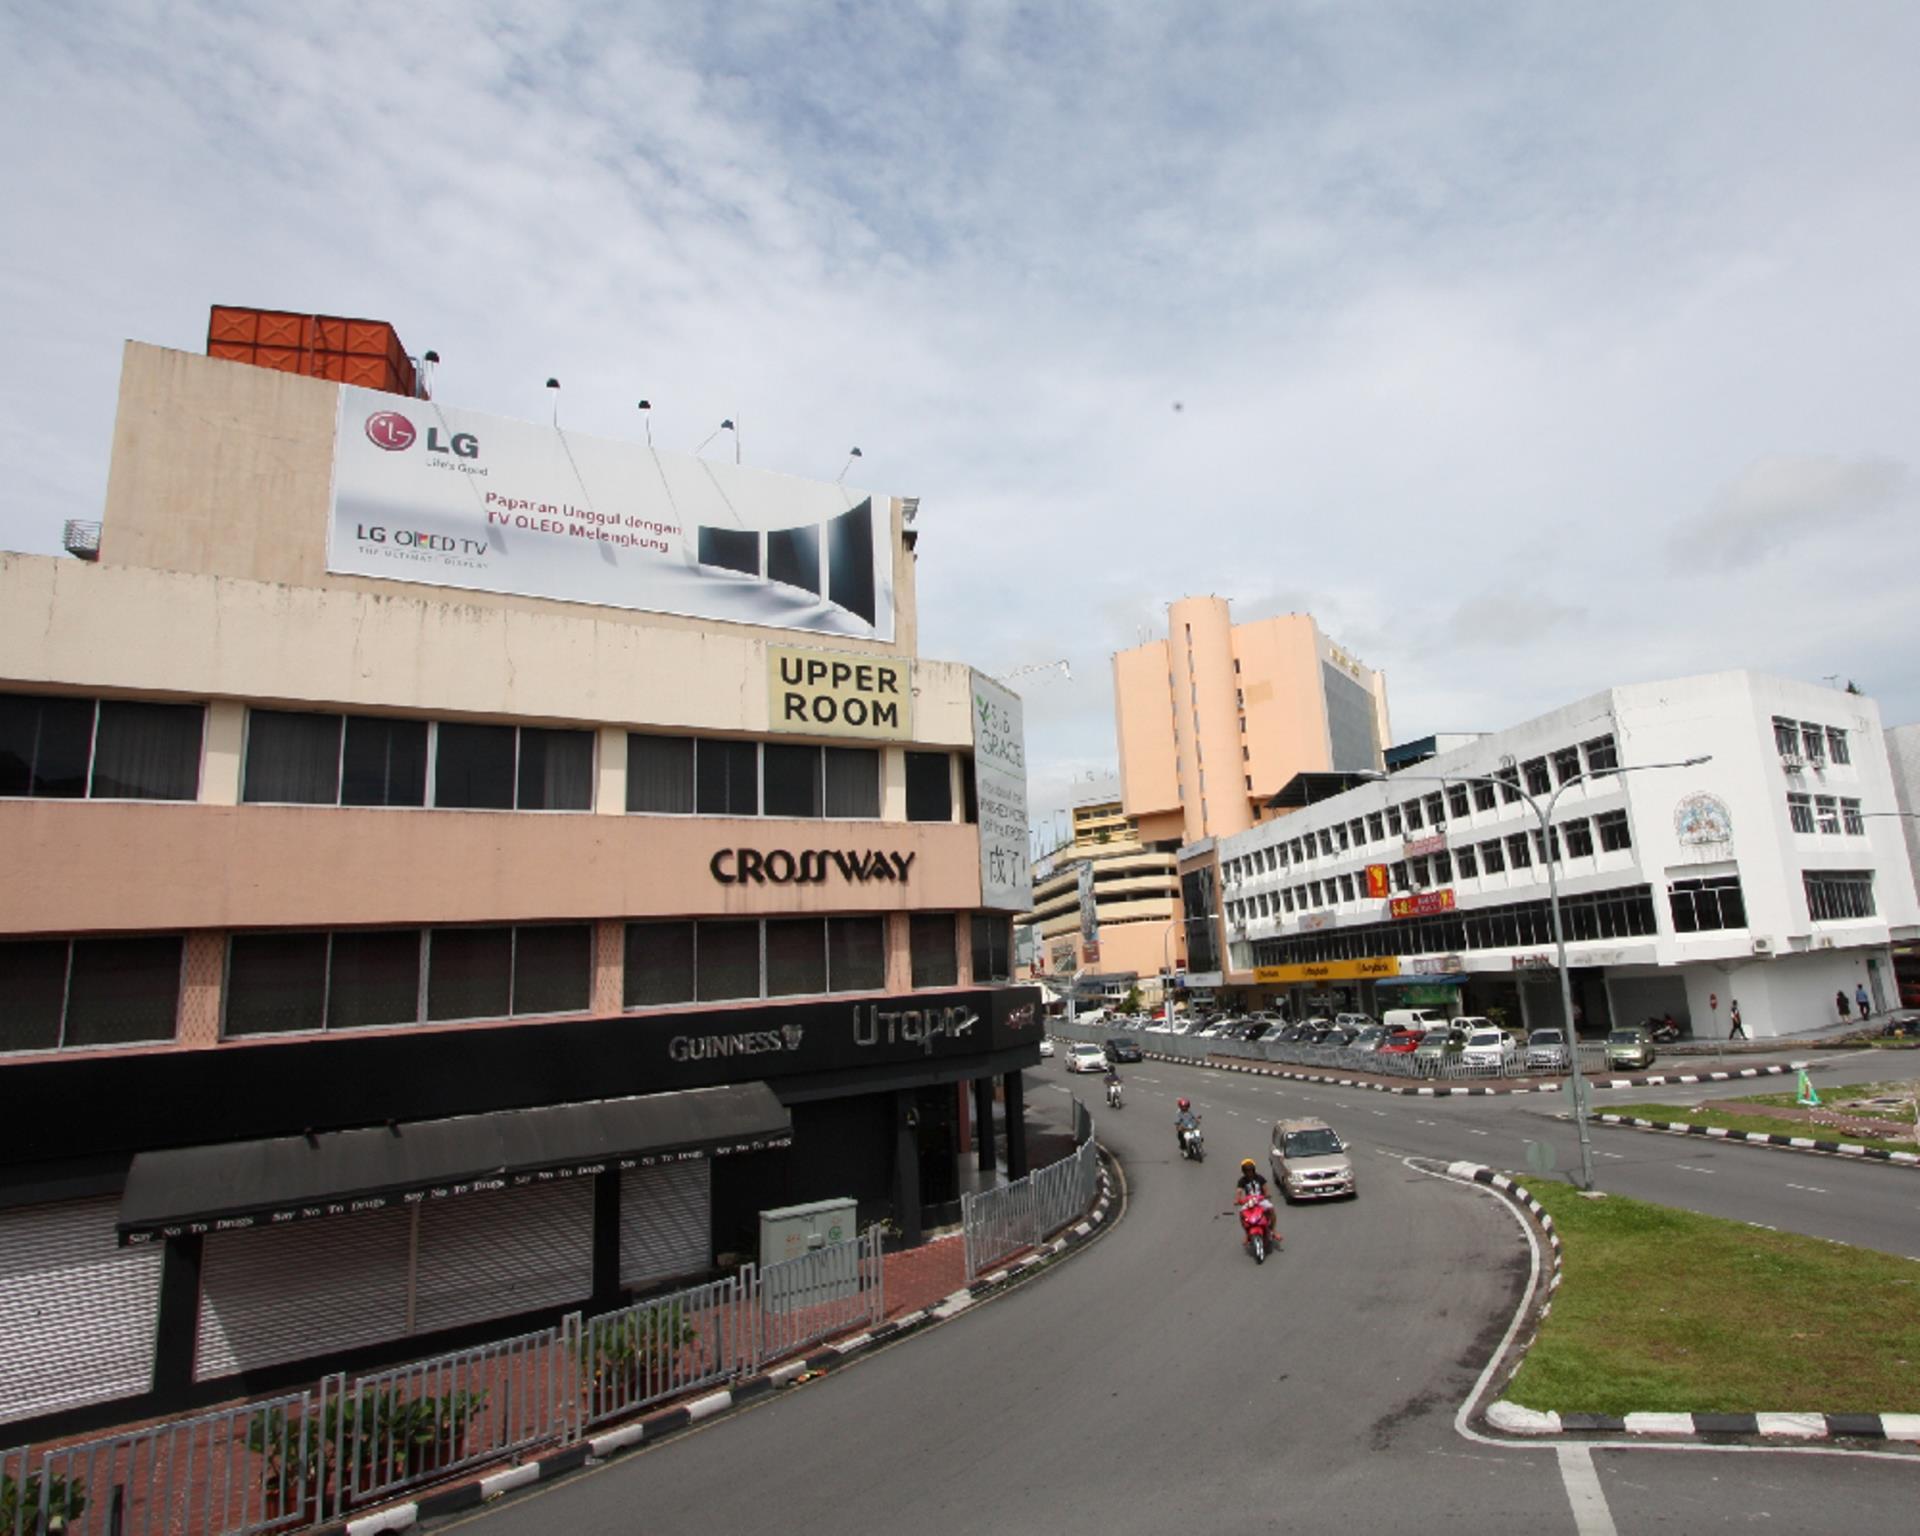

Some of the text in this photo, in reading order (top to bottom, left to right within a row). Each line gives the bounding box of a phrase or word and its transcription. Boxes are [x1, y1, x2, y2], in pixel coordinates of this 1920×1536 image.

[427, 427, 479, 459] LG
[485, 491, 683, 536] Paparan Unggul dengan
[357, 523, 386, 543] LG
[460, 538, 488, 555] TV
[488, 511, 669, 553] TV OLED Melengkung
[384, 550, 438, 564] ULTIMAT
[780, 656, 899, 694] UPPER
[784, 692, 899, 728] ROOM
[710, 848, 916, 885] CROSSWAY
[454, 1184, 468, 1194] To
[473, 1179, 505, 1191] Drugs
[272, 1198, 387, 1222] Say No To Drugs
[128, 1216, 254, 1244] Say No To Drugs
